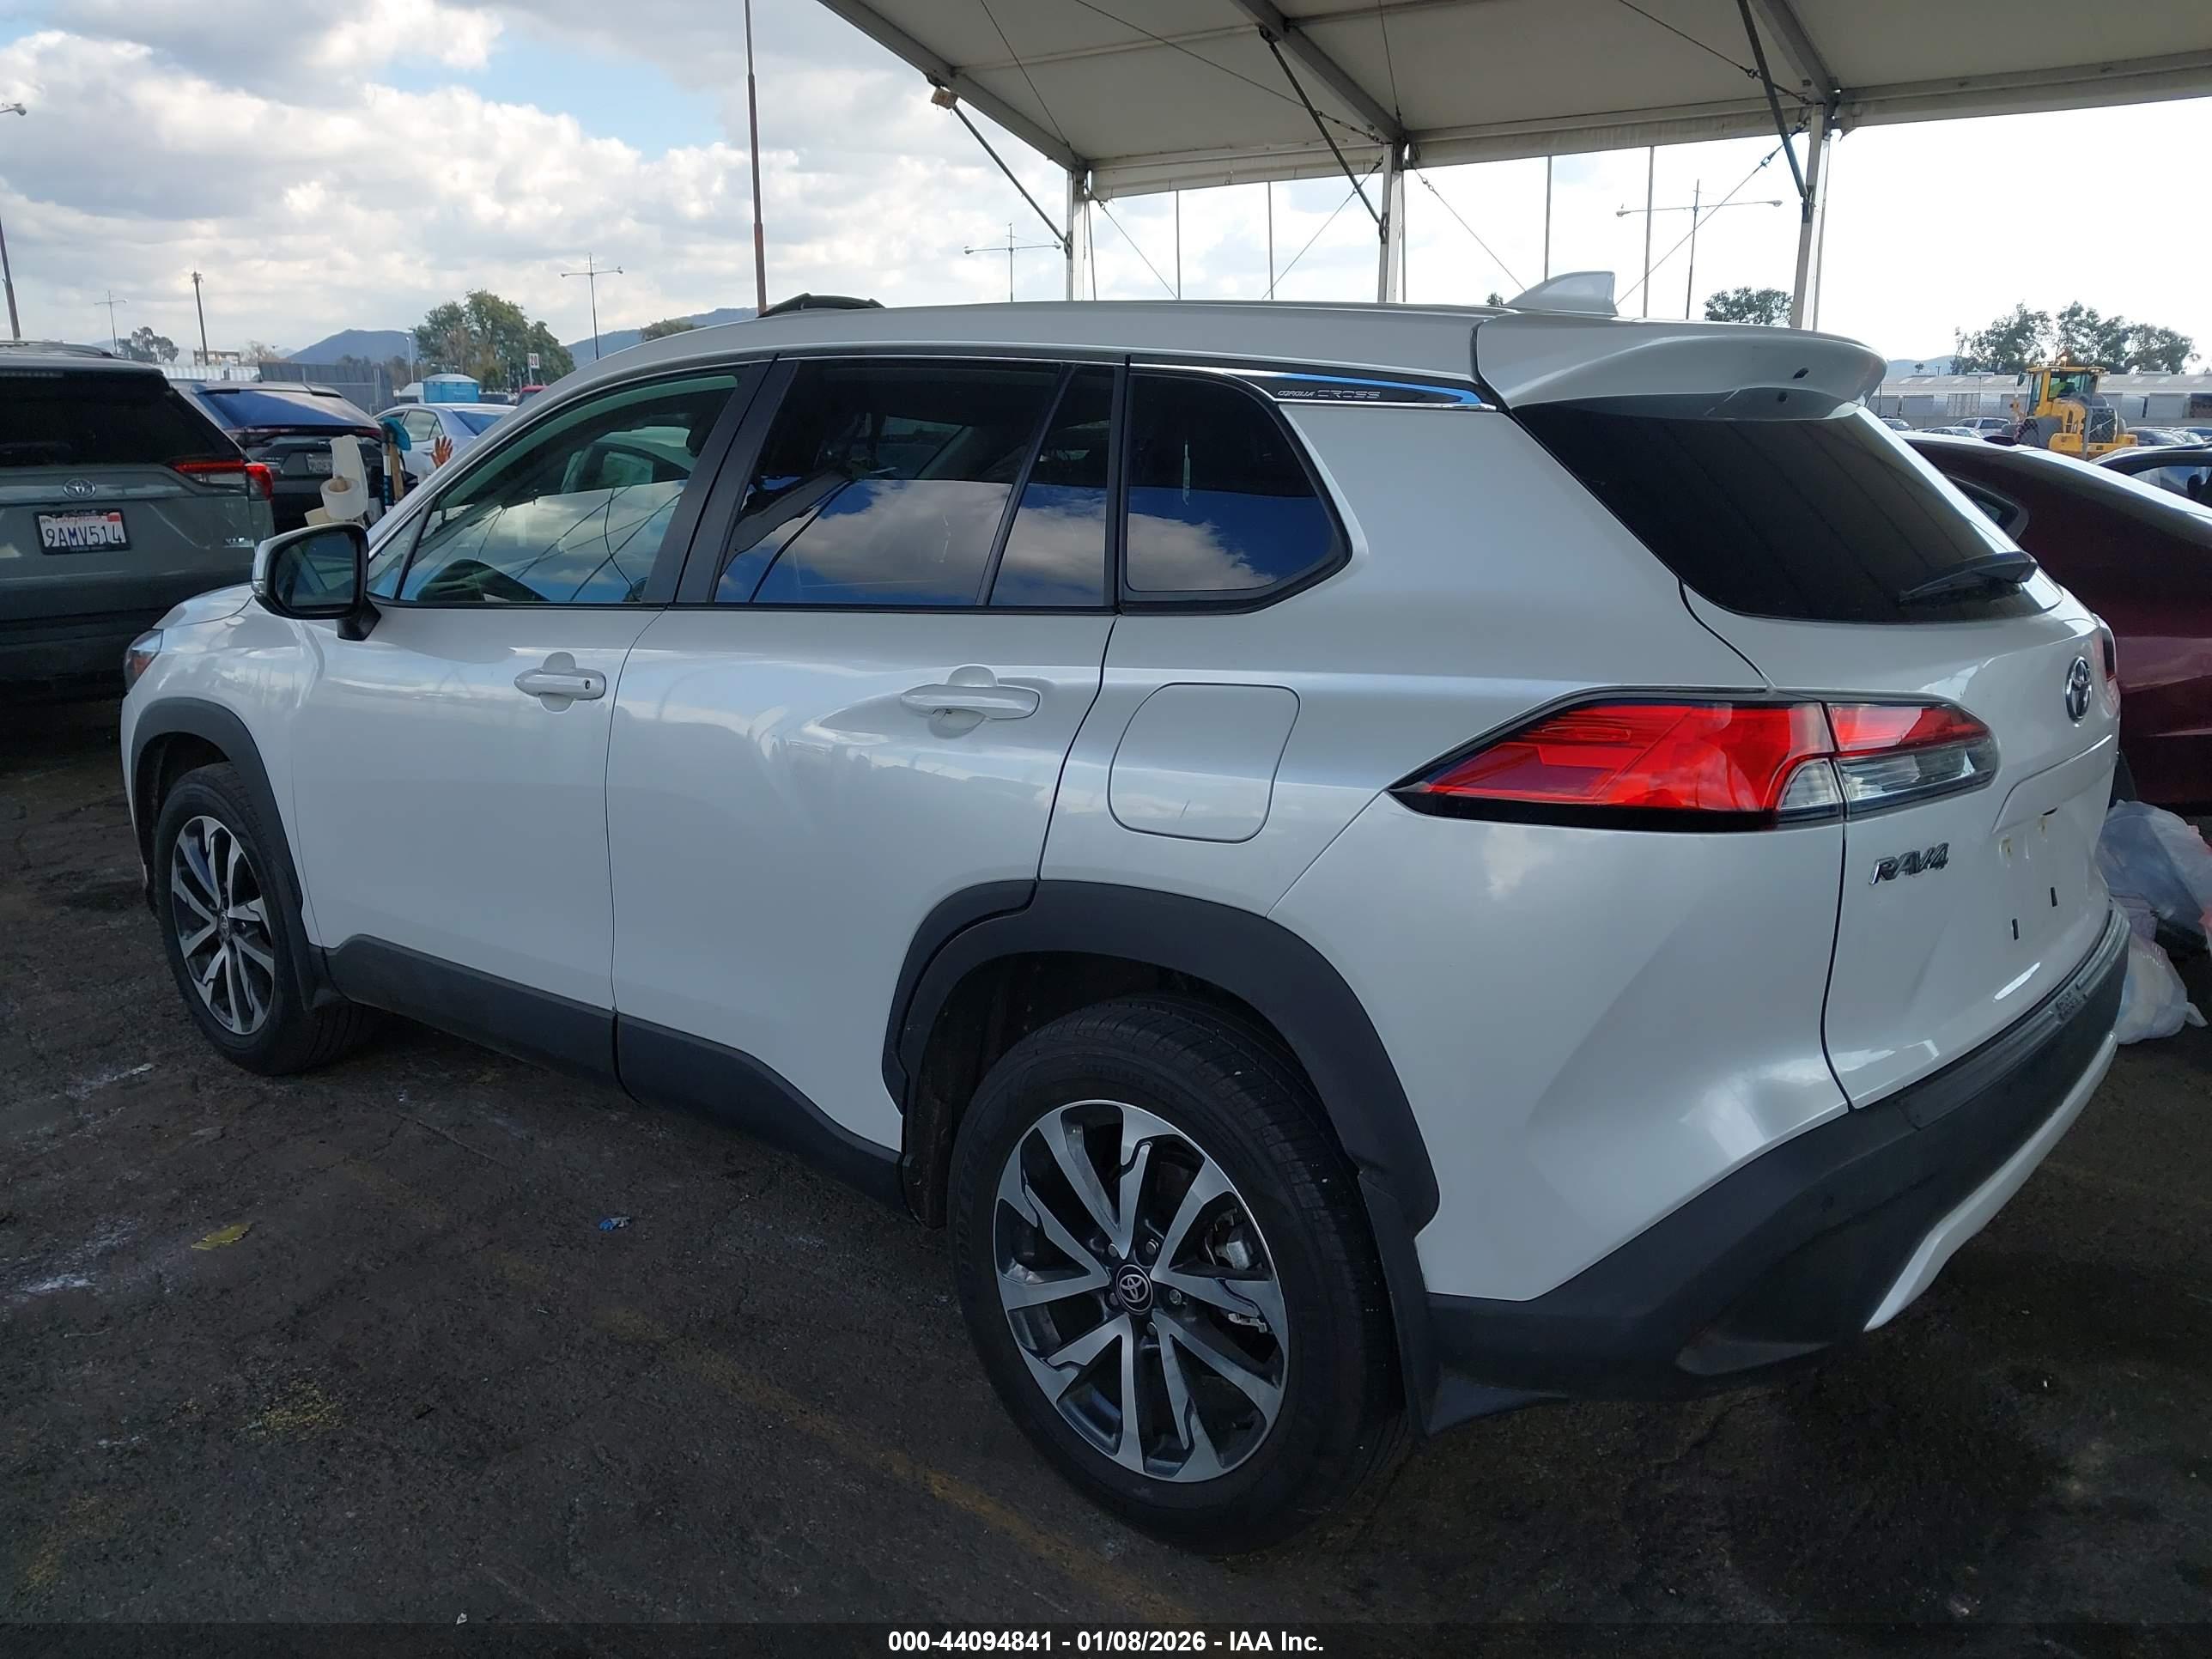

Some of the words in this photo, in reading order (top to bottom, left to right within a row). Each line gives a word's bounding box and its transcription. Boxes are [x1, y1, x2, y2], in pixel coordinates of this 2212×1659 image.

[1317, 390, 1381, 398] CROSS
[46, 525, 123, 548] 9AMV514
[1869, 842, 1949, 885] RAV4
